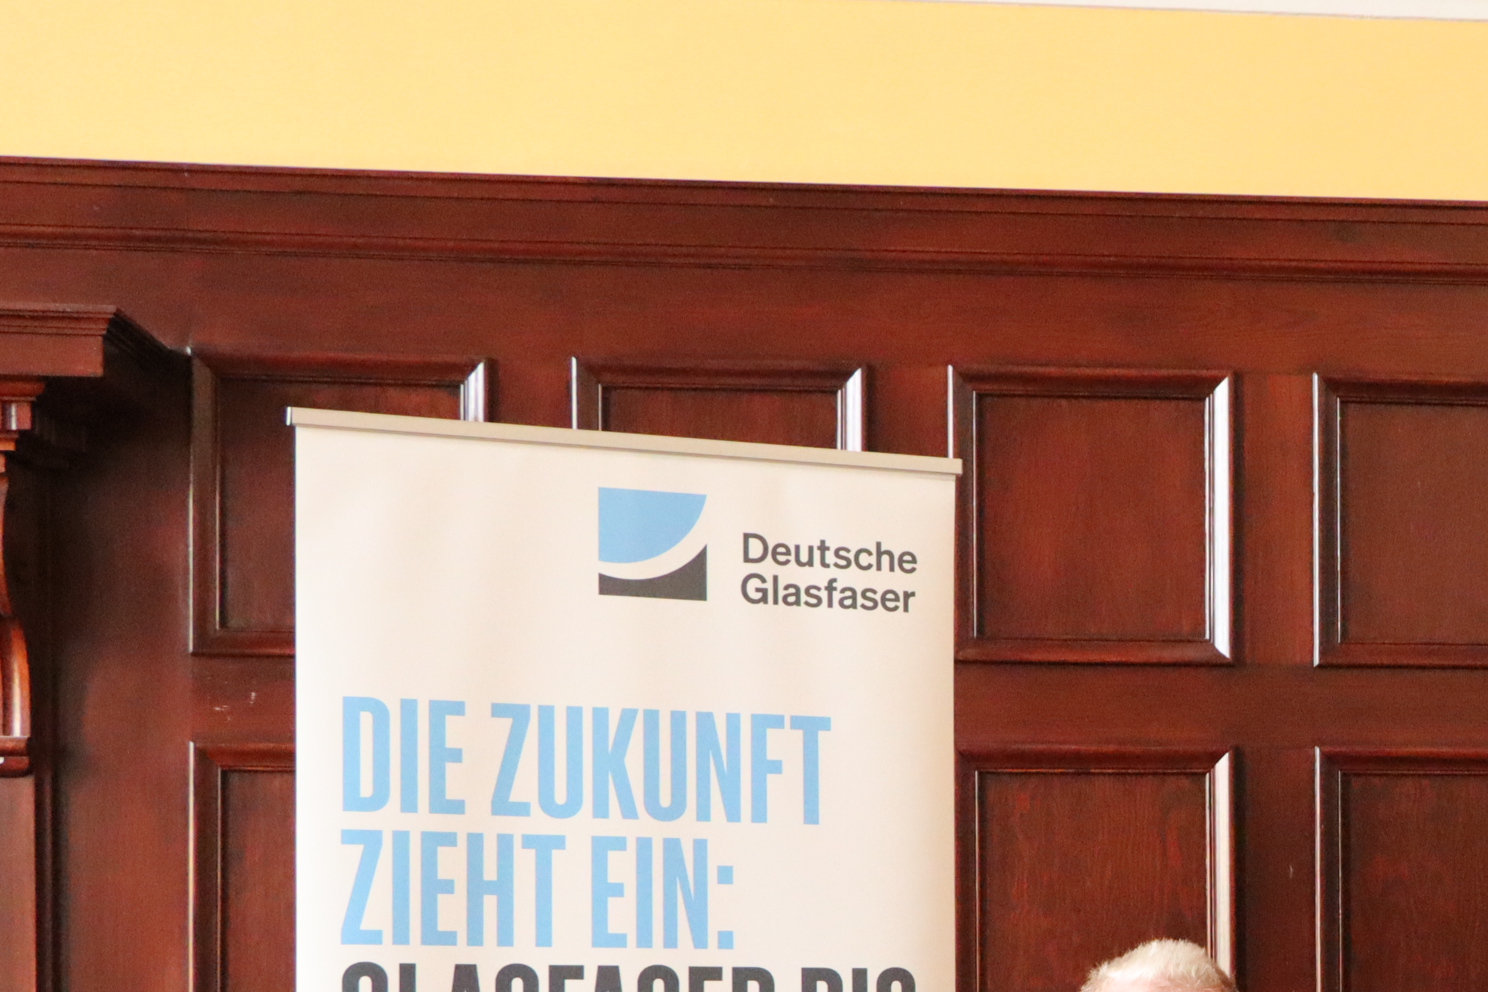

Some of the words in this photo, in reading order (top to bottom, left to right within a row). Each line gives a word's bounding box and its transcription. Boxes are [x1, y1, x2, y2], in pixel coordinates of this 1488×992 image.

[742, 532, 918, 574] Deutsche
[741, 573, 917, 614] Glasfaser
[344, 697, 465, 814] DIE
[491, 703, 831, 824] ZUKUNFT
[342, 830, 565, 947] ZIEHT
[592, 836, 734, 949] EIN:
